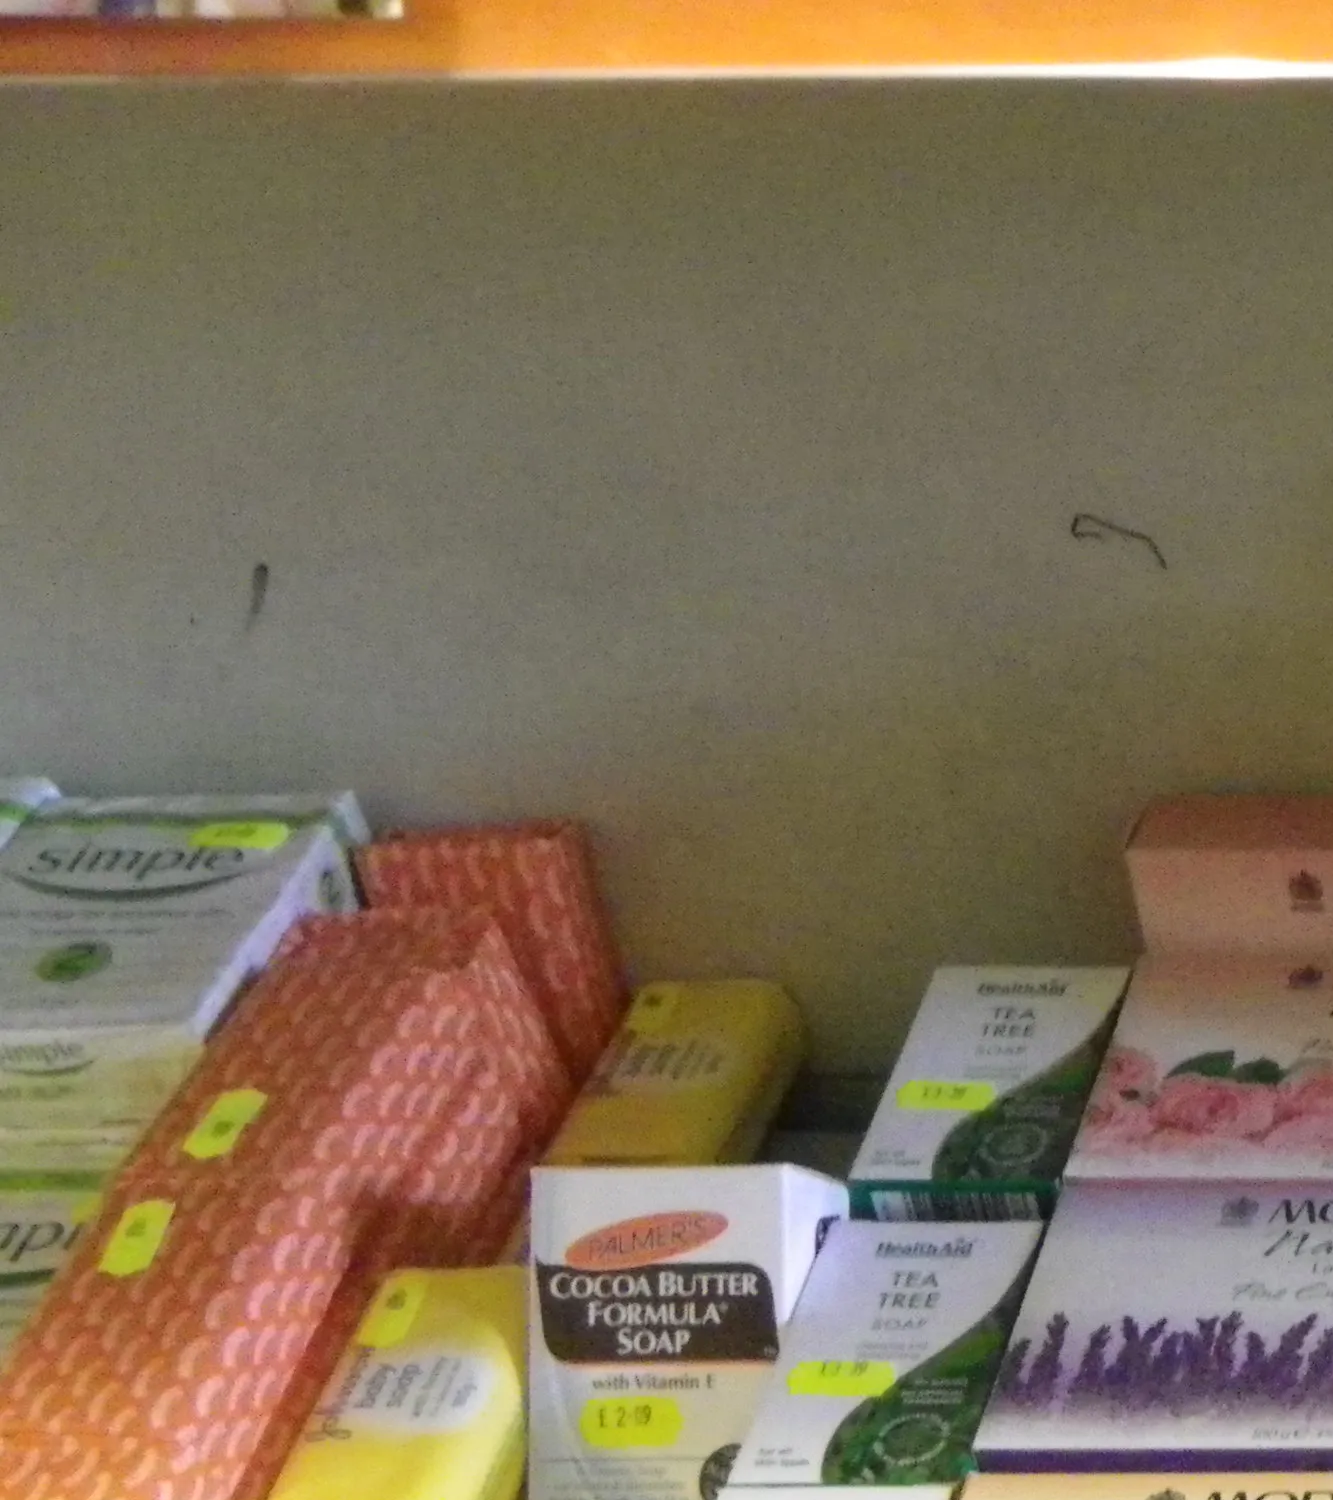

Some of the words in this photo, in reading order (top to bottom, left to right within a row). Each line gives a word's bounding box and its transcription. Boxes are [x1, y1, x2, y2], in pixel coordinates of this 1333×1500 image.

[994, 1006, 1036, 1020] TEA
[982, 1023, 1036, 1038] TREE
[875, 1238, 976, 1259] HealthAid
[549, 1272, 650, 1300] COCOA
[659, 1270, 759, 1297] BUTTER
[891, 1271, 940, 1288] TEA
[877, 1292, 941, 1310] TREE
[588, 1301, 721, 1327] FORMULA
[617, 1328, 690, 1356] SOAP
[591, 1374, 629, 1390] with
[634, 1373, 699, 1390] Vitamin
